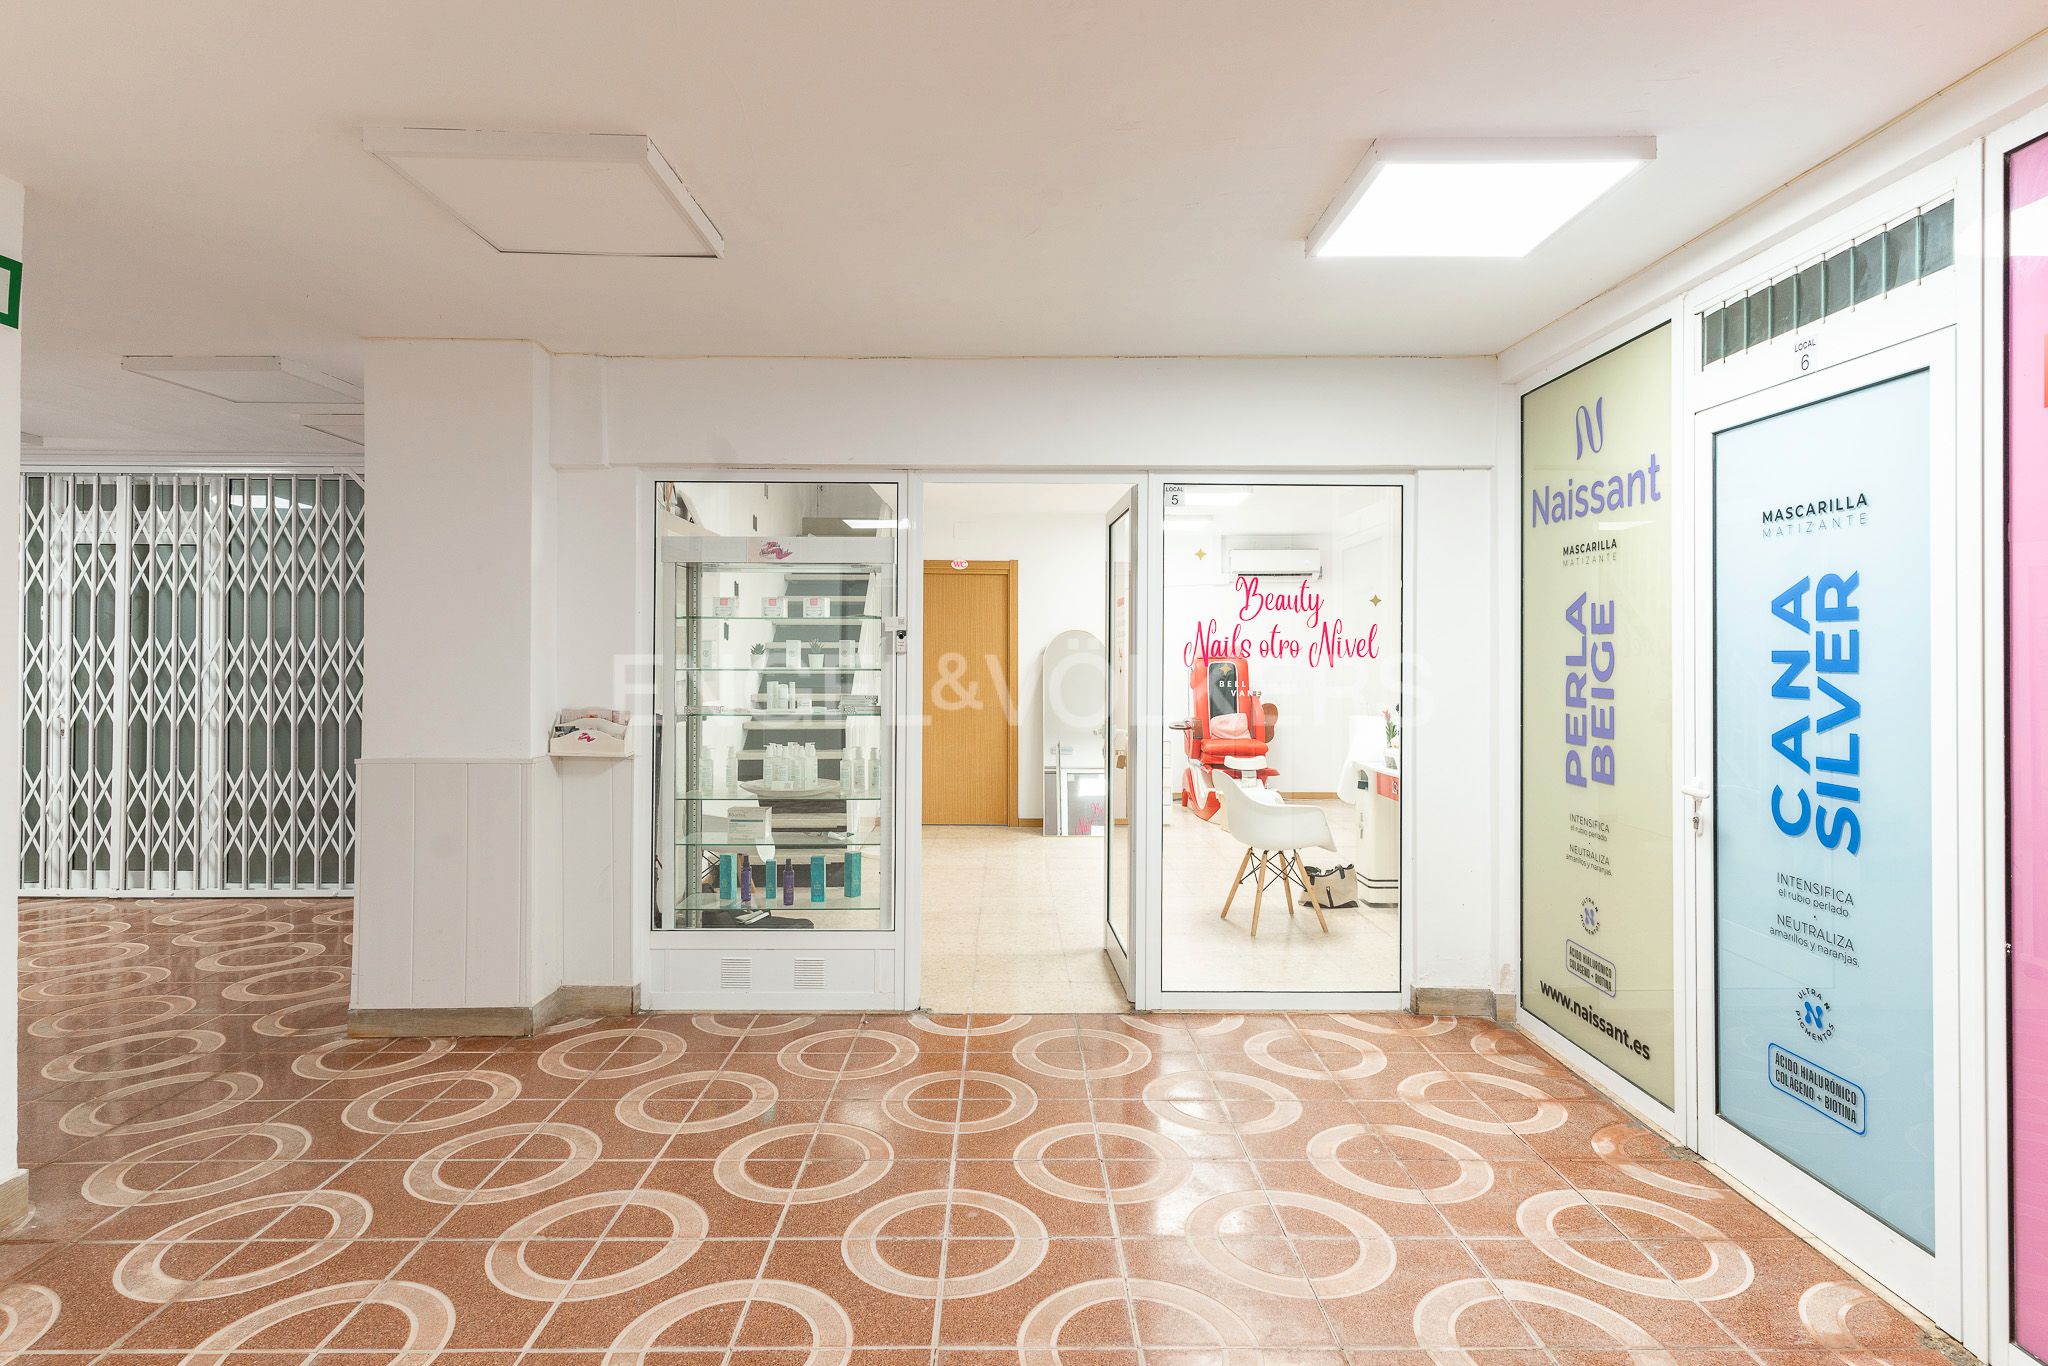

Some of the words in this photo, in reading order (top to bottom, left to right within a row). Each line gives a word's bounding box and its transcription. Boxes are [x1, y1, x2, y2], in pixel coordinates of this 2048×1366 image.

[1794, 338, 1816, 354] LOCAL
[1799, 354, 1810, 371] 6
[1171, 494, 1179, 506] 5
[1531, 453, 1662, 529] Naissant
[1761, 492, 1869, 525] MASCARILLA
[1761, 513, 1868, 539] MATIZANTE
[1562, 538, 1618, 556] MASCARILLA
[1562, 552, 1617, 568] MATIZANTE
[953, 560, 967, 568] WC
[1235, 576, 1325, 628] Beauty
[1184, 618, 1251, 669] Nails
[1259, 622, 1303, 660] otro
[1308, 618, 1380, 669] Nivel
[1565, 591, 1588, 789] PERLA
[1590, 599, 1616, 787] BEIGE
[1770, 575, 1812, 837] CANA
[1815, 570, 1862, 856] SILVER
[1569, 813, 1610, 833] INTENSIFICA
[1569, 844, 1610, 866] NEUTRALIZA
[1776, 872, 1854, 906] INTENSIFICA
[1778, 888, 1787, 898] el
[1787, 890, 1811, 906] rubio
[1813, 898, 1850, 918] perlado
[1769, 926, 1809, 948] amarillos
[1809, 939, 1816, 951] y
[1776, 914, 1855, 952] NEUTRALIZA
[1797, 987, 1822, 1001] ULTRA
[1540, 979, 1651, 1060] www.naissant.es
[1795, 1010, 1835, 1042] PIGMENTOS
[1774, 1050, 1798, 1076] ÁCIDO
[1799, 1063, 1857, 1107] HIALURÓNICO
[1775, 1069, 1815, 1102] COLÁGENO
[1824, 1096, 1857, 1125] BIOTINA
